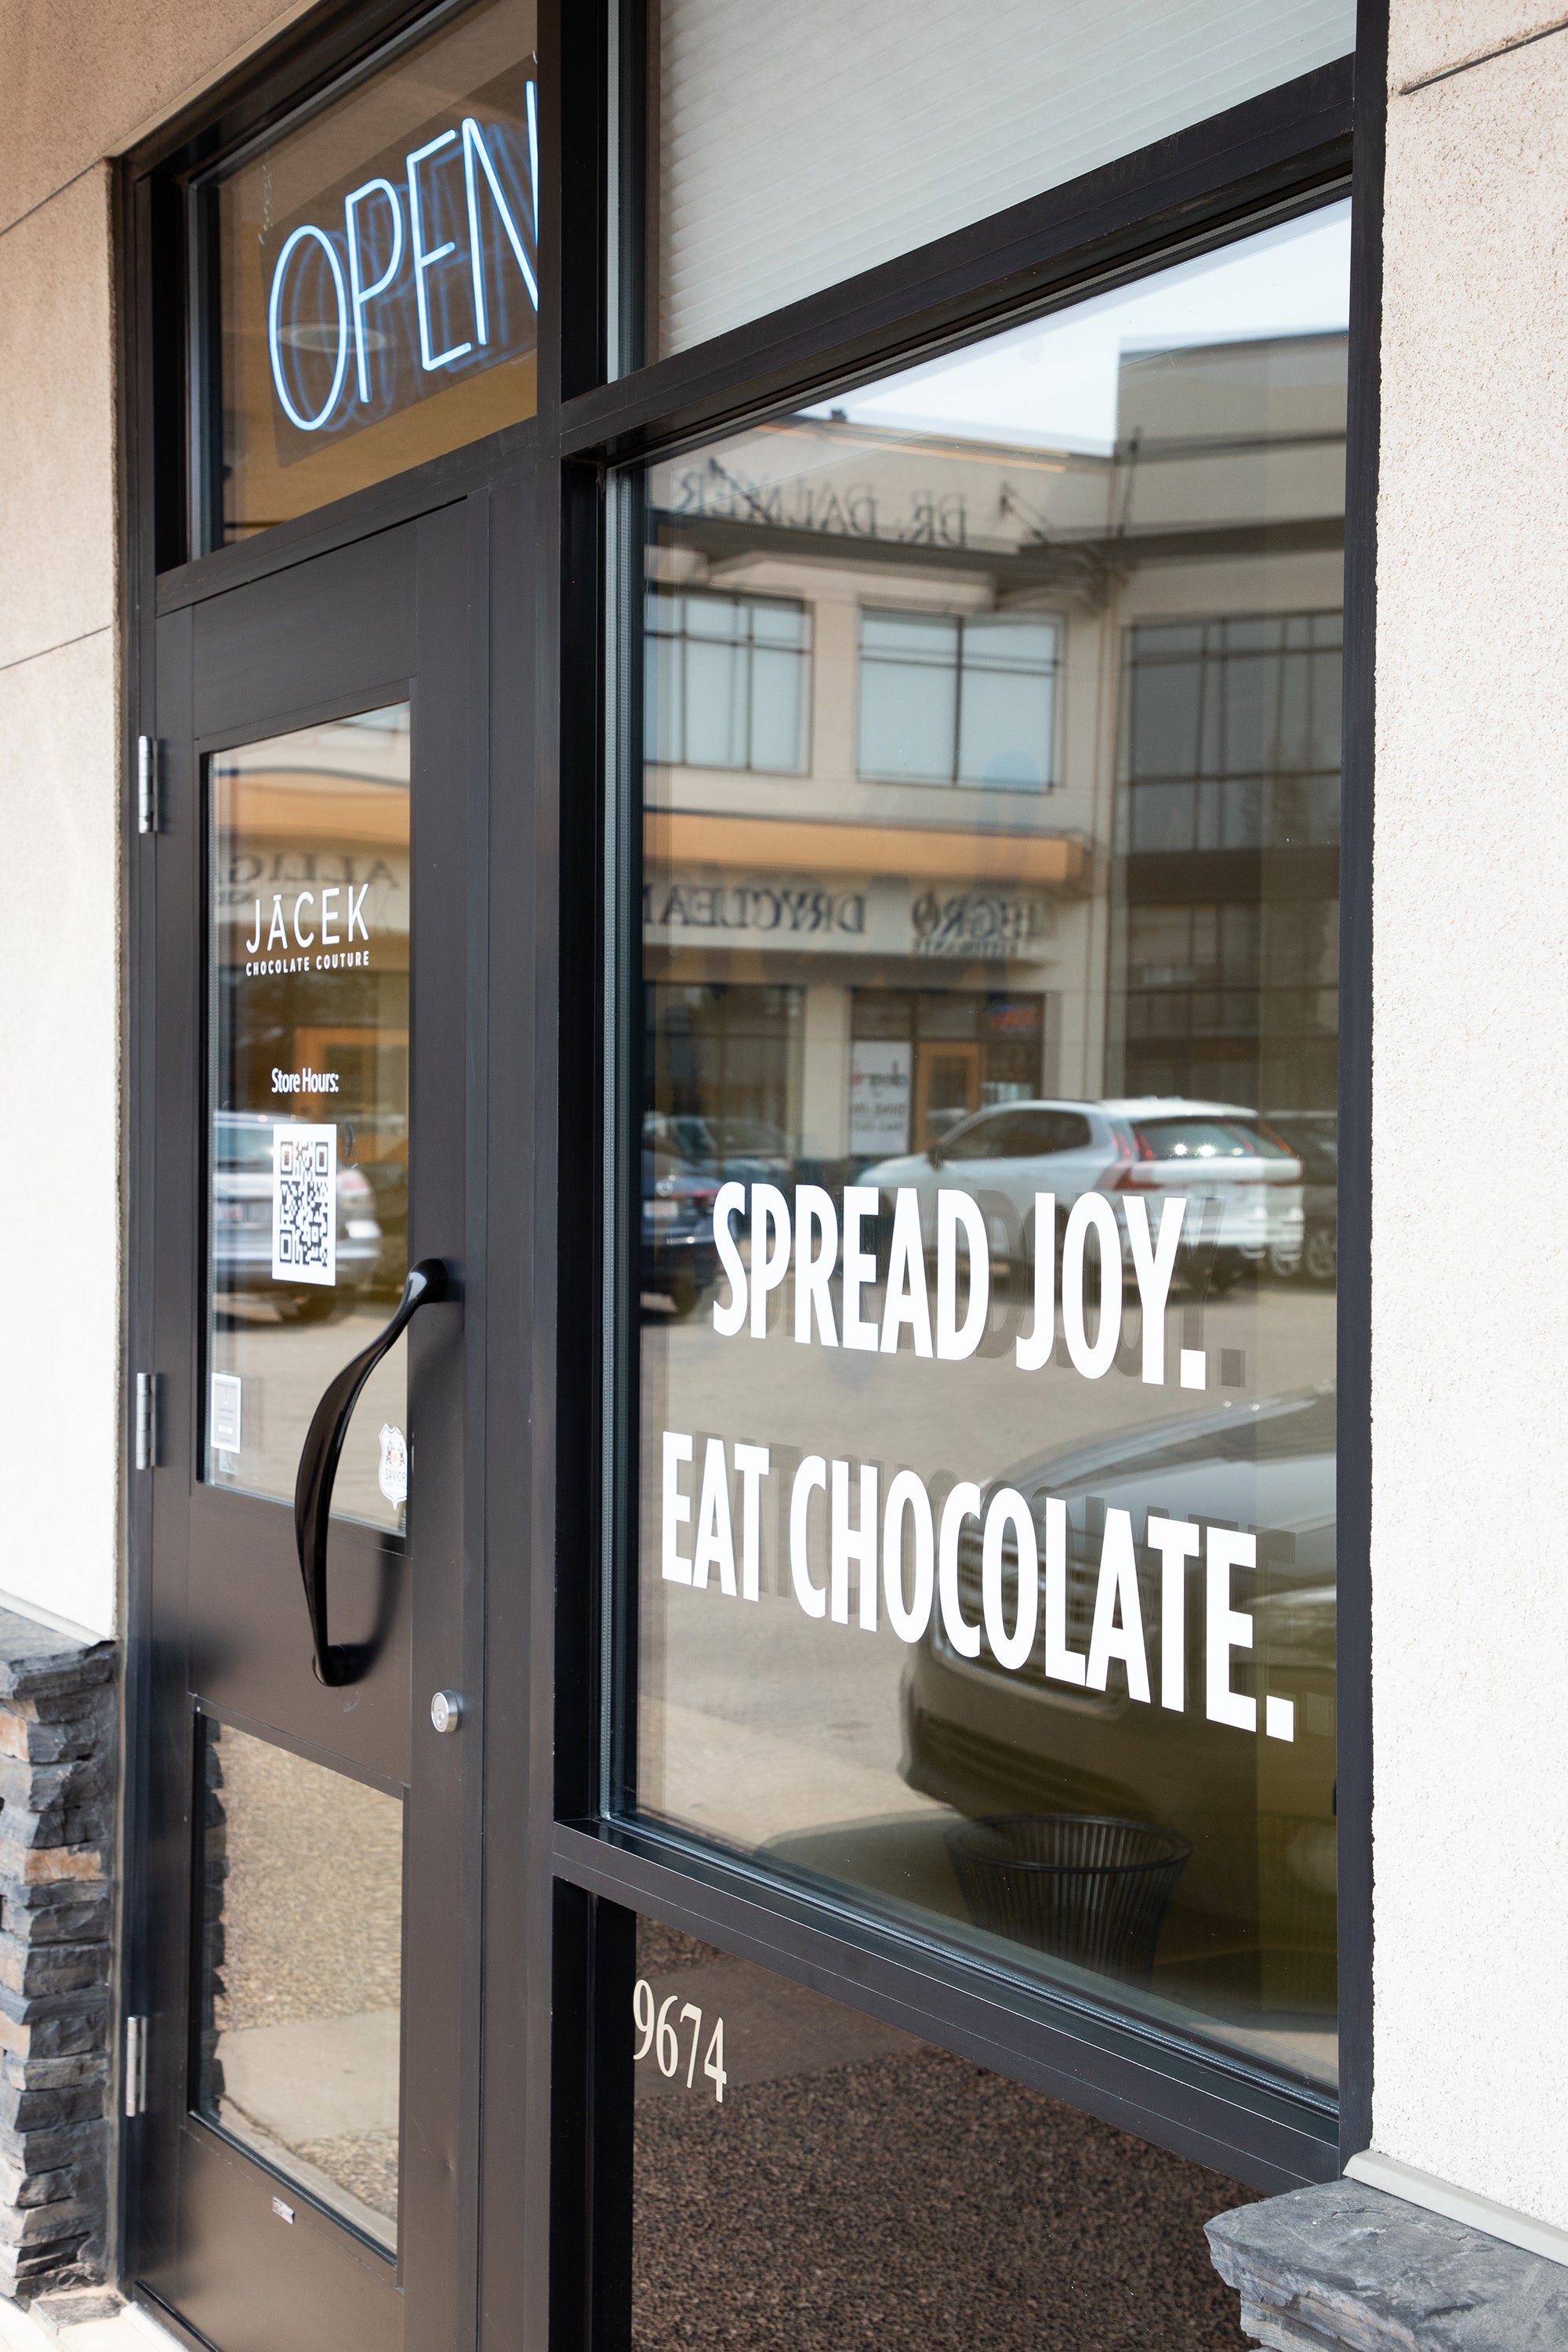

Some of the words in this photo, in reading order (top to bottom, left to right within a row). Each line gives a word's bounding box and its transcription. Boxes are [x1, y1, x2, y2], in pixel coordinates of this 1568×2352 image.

[269, 81, 539, 431] OPEN
[245, 956, 310, 977] CHOCOLATE
[315, 950, 369, 971] COUTURE
[271, 1068, 301, 1093] Store
[302, 1068, 339, 1093] Hours:
[713, 1181, 989, 1361] SPREAD
[1016, 1192, 1207, 1390] JOY.
[662, 1431, 770, 1602] EAT
[789, 1455, 1294, 1743] CHOCOLATE.
[633, 1979, 727, 2103] 9674
